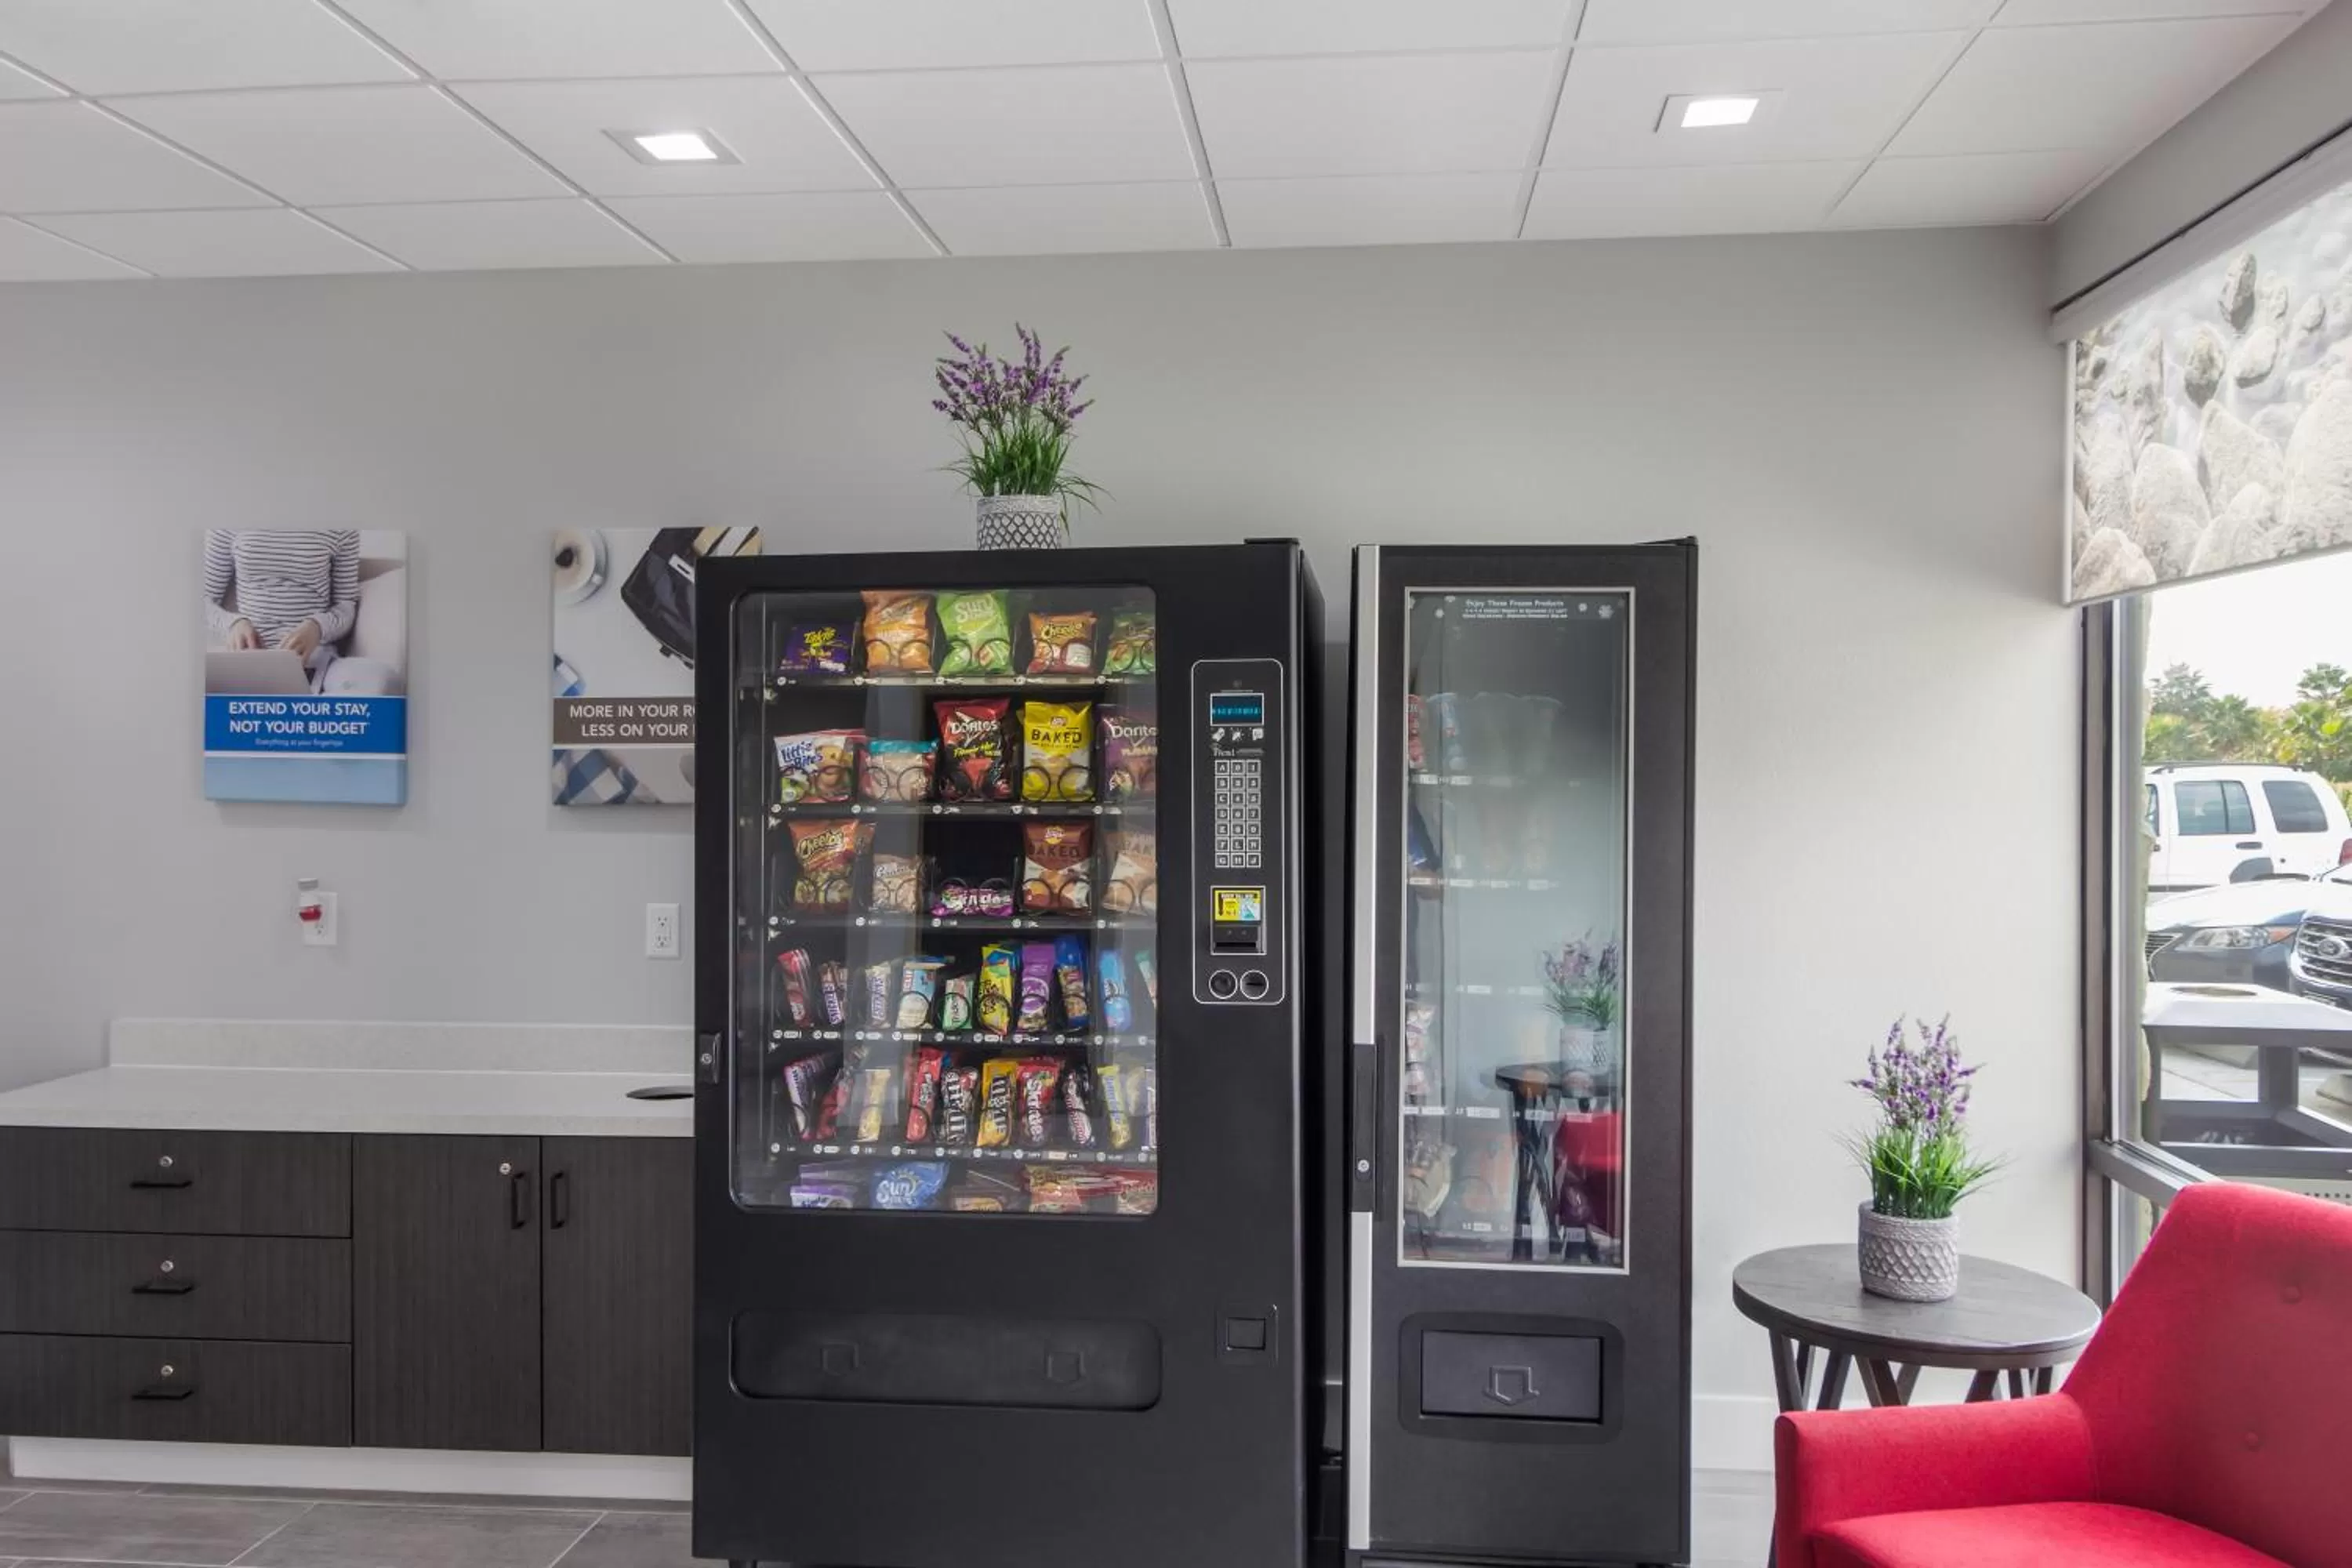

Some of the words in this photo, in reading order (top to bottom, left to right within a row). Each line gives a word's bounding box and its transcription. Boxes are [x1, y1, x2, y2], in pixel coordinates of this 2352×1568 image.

[229, 702, 287, 715] EXTEND
[291, 702, 330, 717] YOUR
[335, 703, 371, 718] STAY,
[570, 705, 614, 717] MORE
[618, 705, 633, 717] IN
[638, 704, 678, 717] YOUR
[230, 720, 263, 733] NOT
[266, 720, 304, 734] YOUR
[308, 721, 368, 735] BUDGET
[581, 724, 615, 736] LESS
[619, 724, 643, 736] ON
[648, 724, 688, 737] YOUR
[1032, 728, 1081, 743] BAKED
[876, 1179, 911, 1203] Sun
